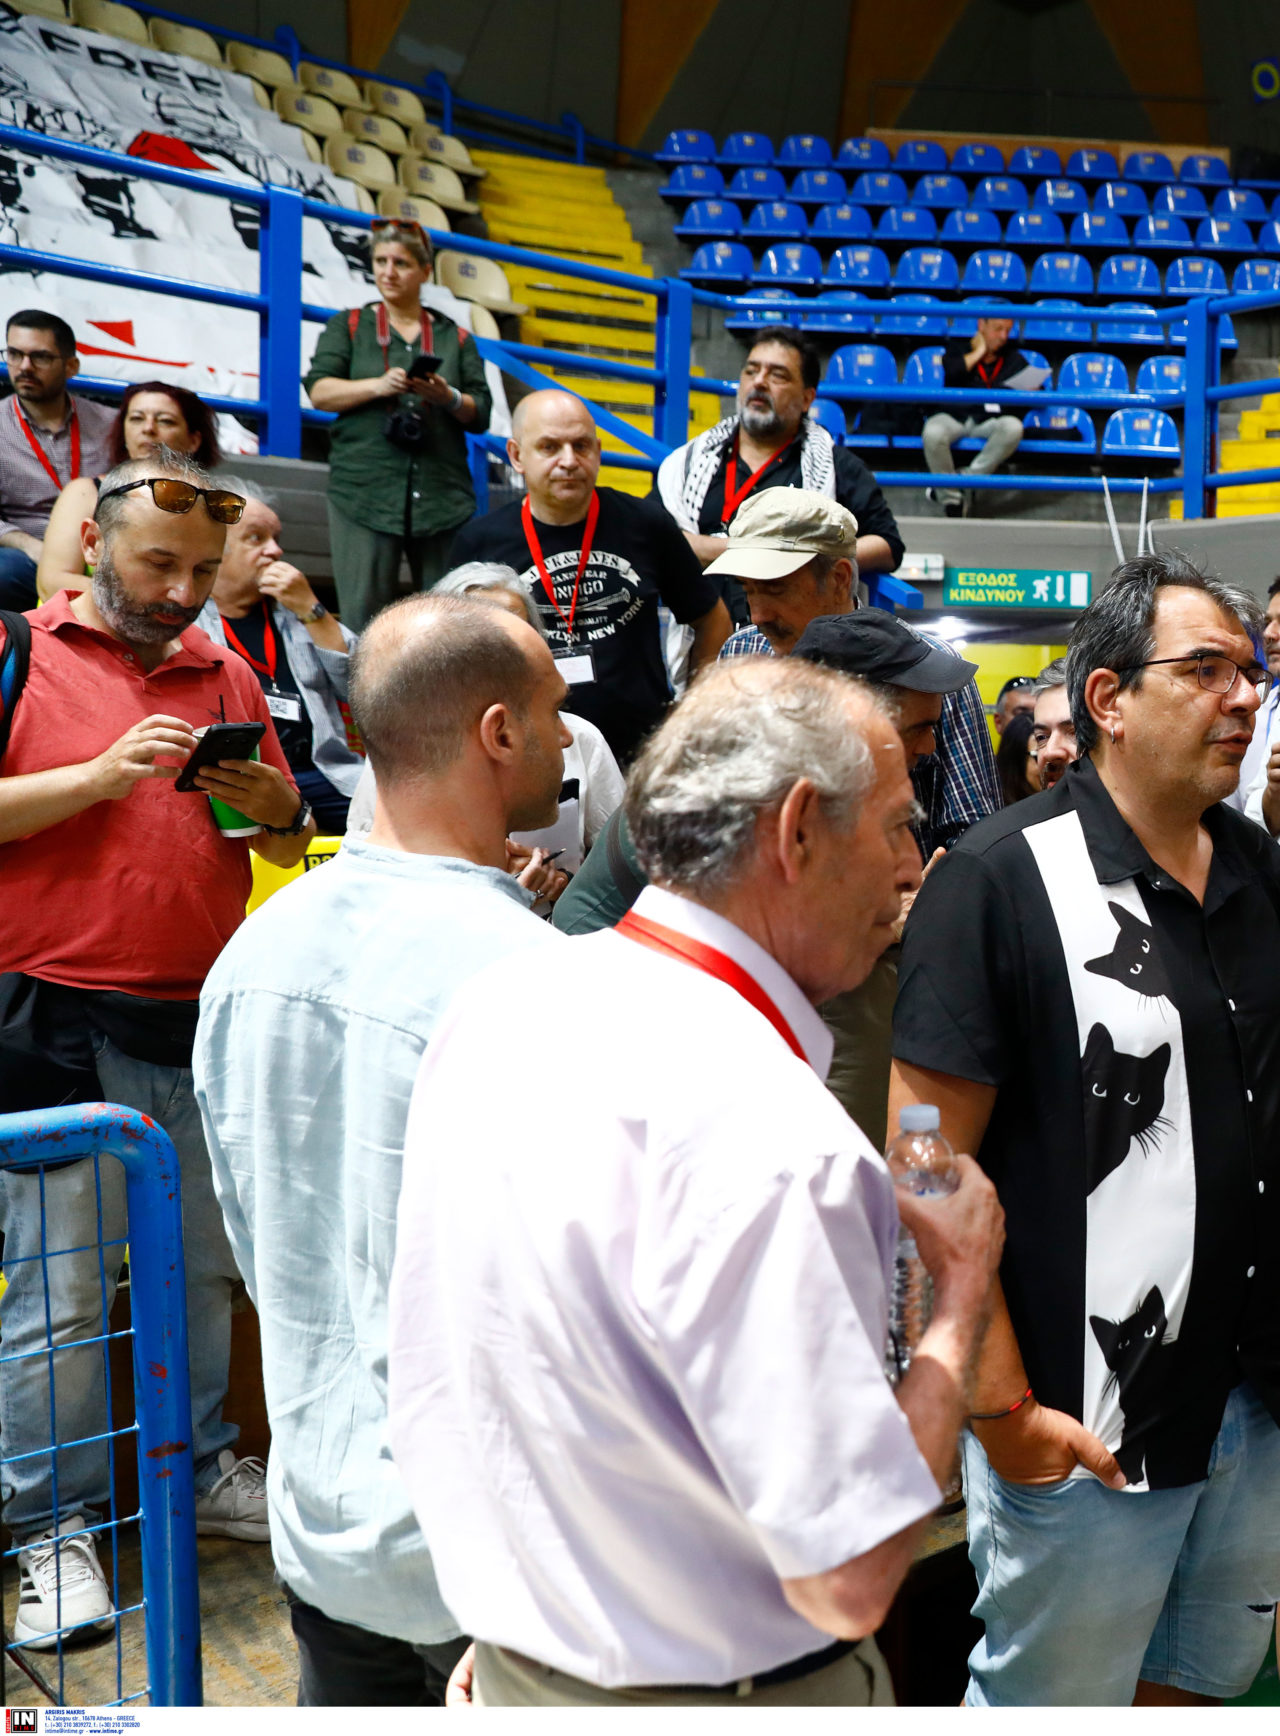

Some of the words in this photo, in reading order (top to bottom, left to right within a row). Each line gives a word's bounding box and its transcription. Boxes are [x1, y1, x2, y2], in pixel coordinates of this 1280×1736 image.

[958, 572, 1018, 587] ΕΞΟΔΟΣ
[949, 588, 1026, 602] ΚΙΝΔΥΝΟΥ
[587, 622, 616, 641] NEW
[616, 596, 645, 626] YORK
